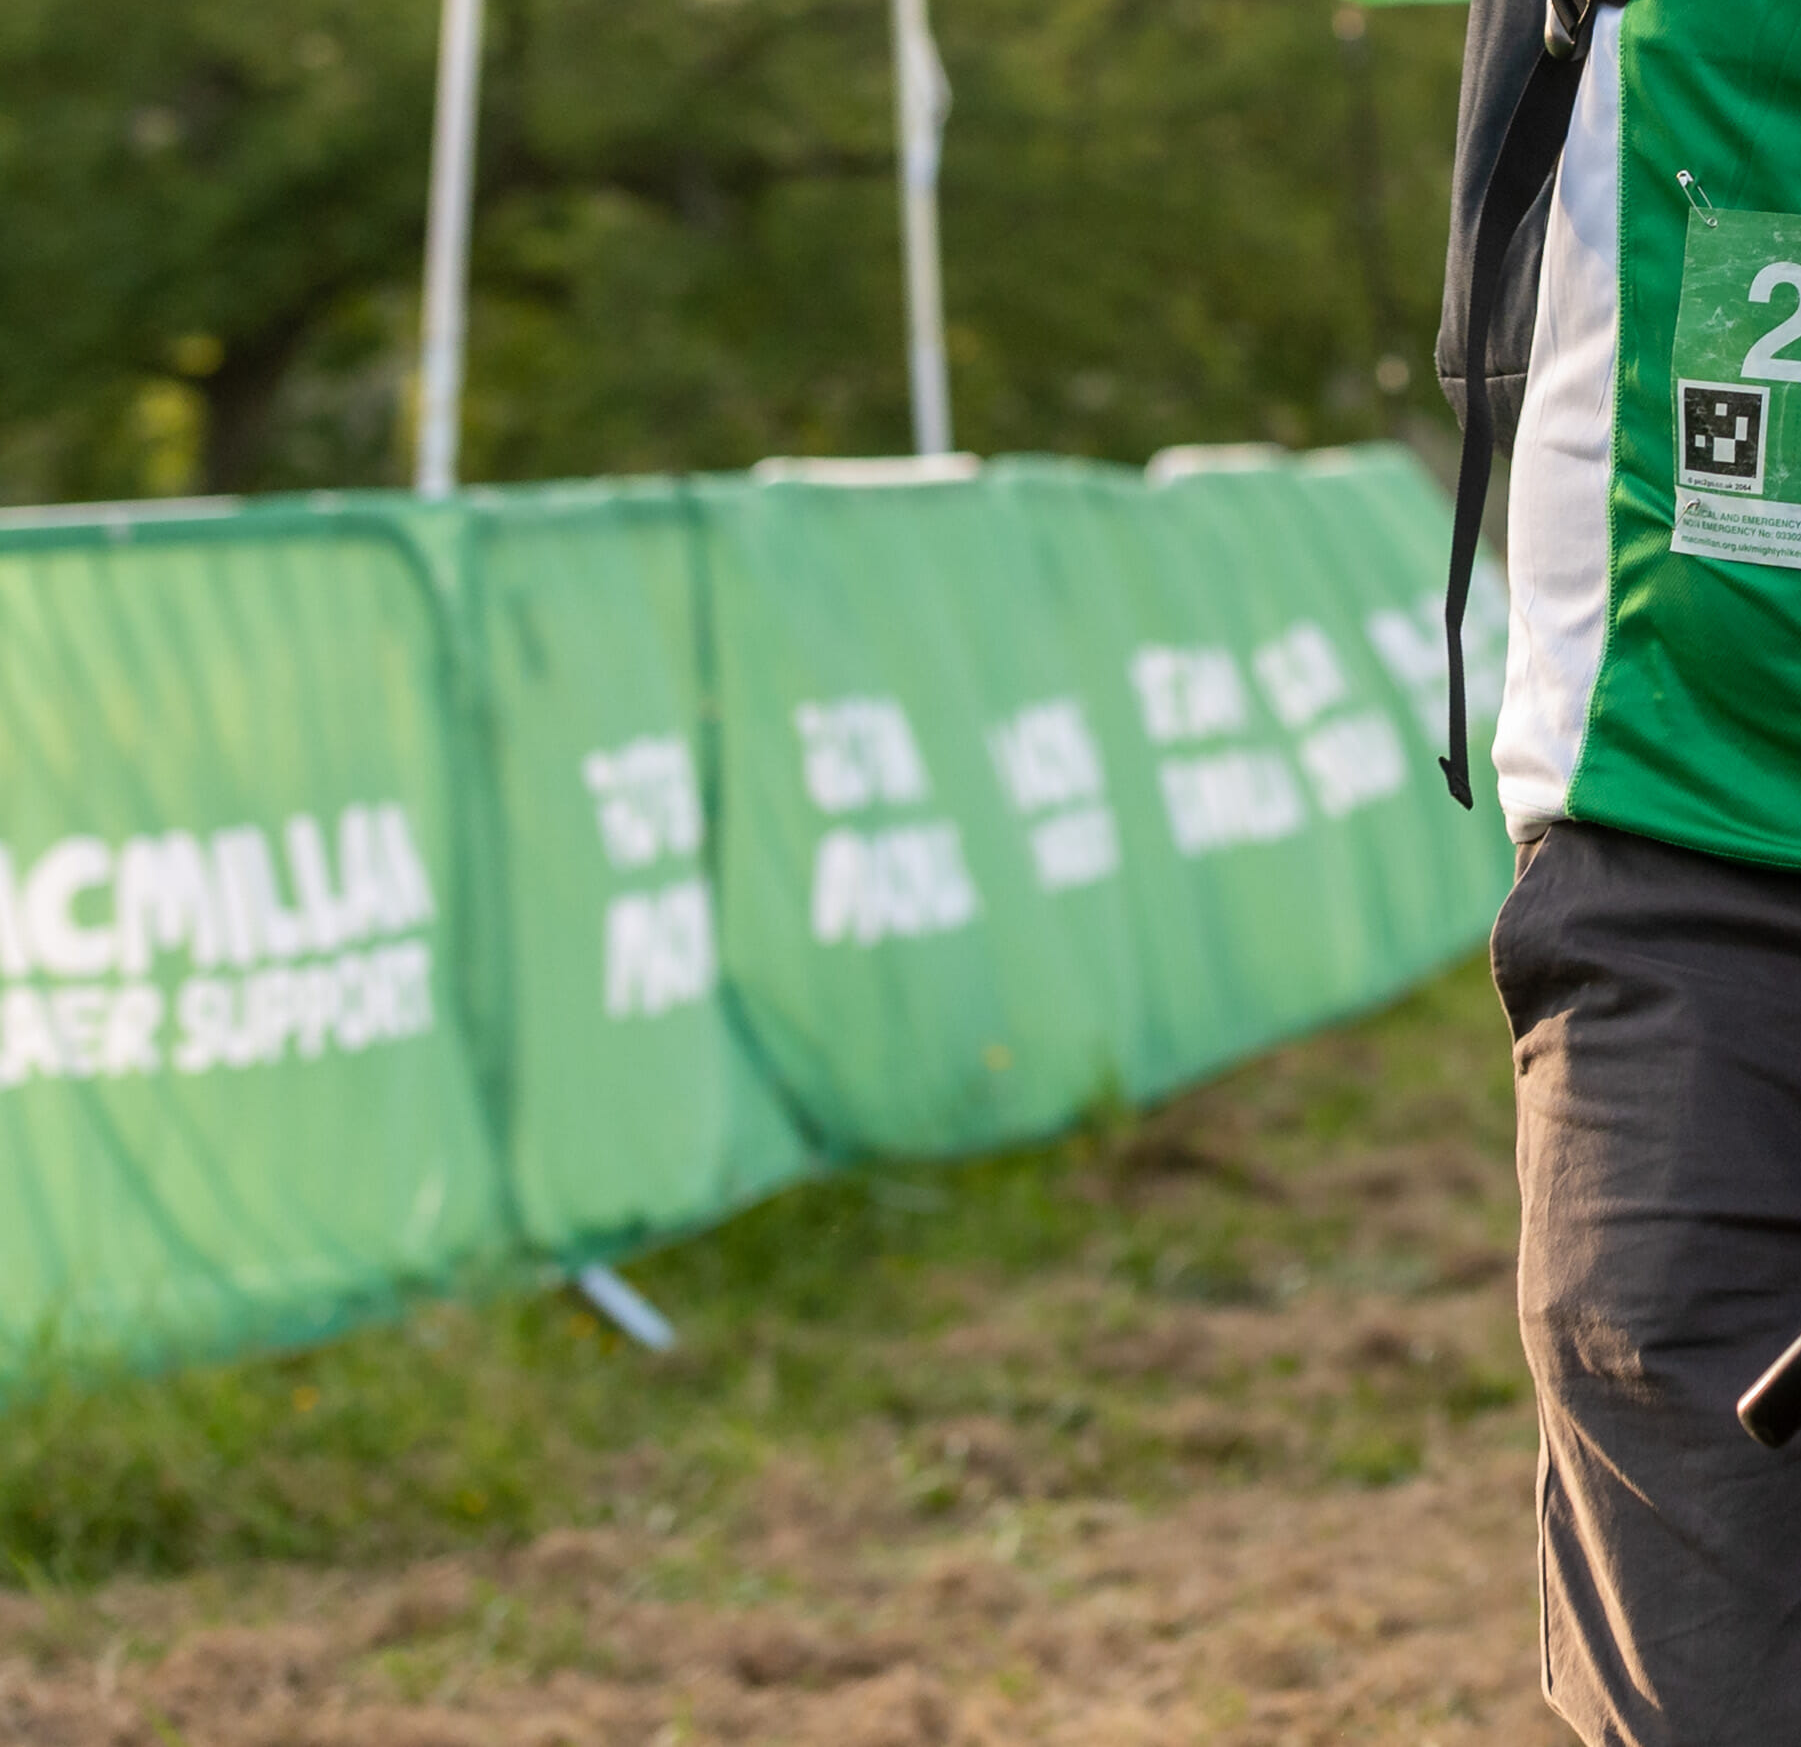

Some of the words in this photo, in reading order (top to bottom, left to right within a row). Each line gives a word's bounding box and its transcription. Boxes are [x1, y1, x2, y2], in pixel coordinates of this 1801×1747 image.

[1702, 520, 1757, 537] EMERGENCY
[1720, 513, 1740, 523] AND
[1742, 515, 1801, 530] EMERGENCY
